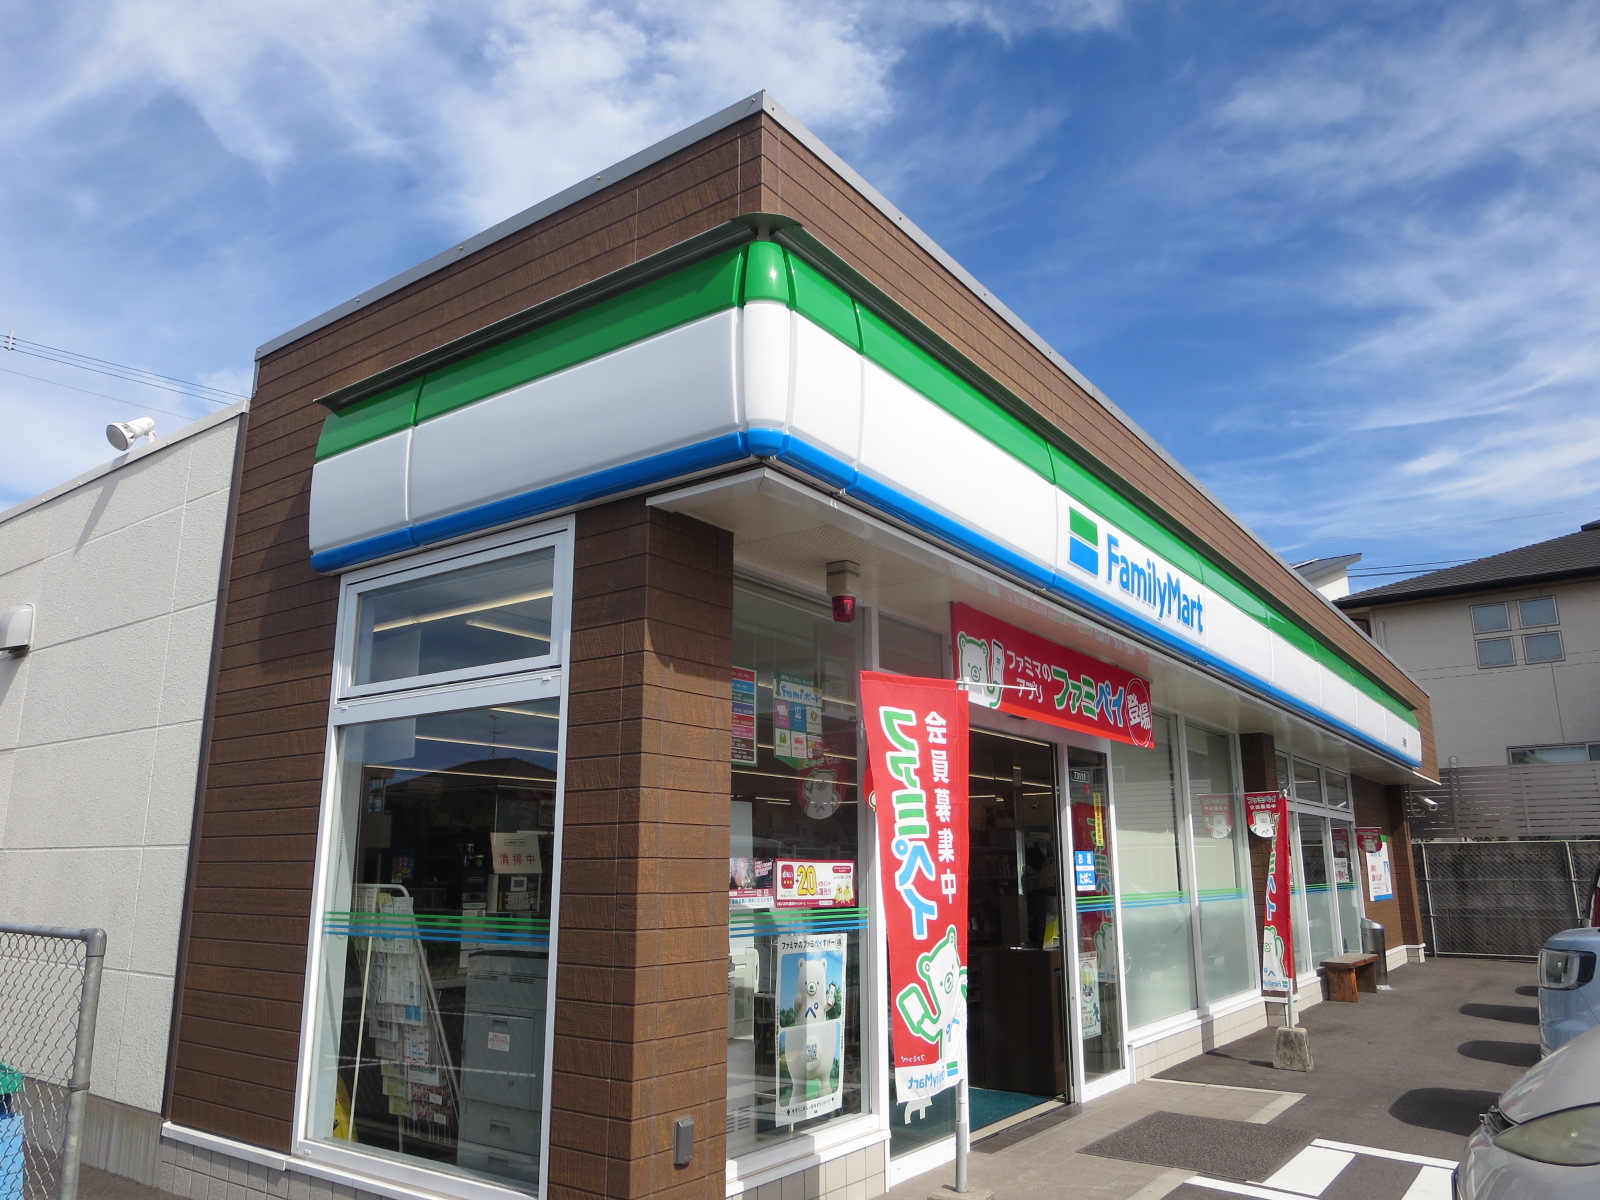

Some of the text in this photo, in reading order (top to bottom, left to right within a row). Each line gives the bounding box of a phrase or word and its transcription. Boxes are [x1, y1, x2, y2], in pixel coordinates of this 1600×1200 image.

[1106, 533, 1204, 633] FamilyMart
[1007, 650, 1052, 682] ファミマの
[1015, 677, 1044, 704] アプリ
[1051, 665, 1125, 728] ファミペイ
[1127, 692, 1152, 730] 登場
[1247, 795, 1277, 804] ファミペイ
[499, 853, 535, 866] 清掃中
